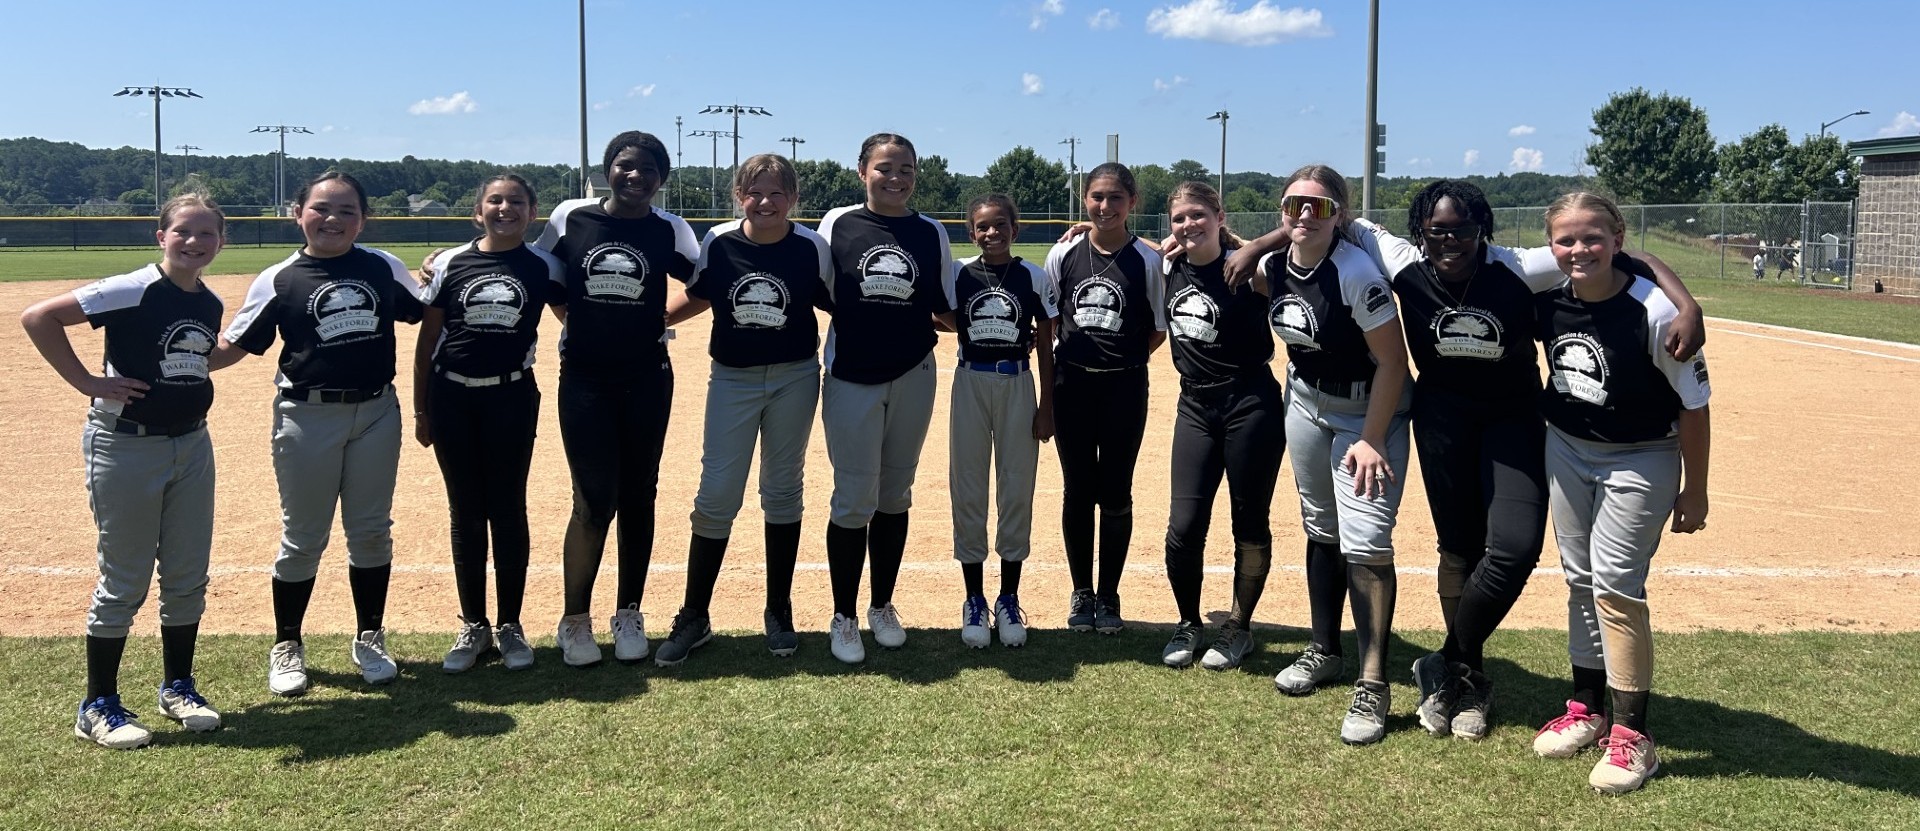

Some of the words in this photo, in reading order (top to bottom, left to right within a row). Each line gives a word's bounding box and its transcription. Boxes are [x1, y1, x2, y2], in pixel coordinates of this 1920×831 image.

[610, 283, 638, 294] FOREST
[884, 284, 908, 295] FOREST
[1462, 306, 1488, 316] Cultural
[467, 313, 487, 321] WAKE
[488, 313, 516, 323] FOREST
[755, 313, 781, 324] FOREST
[321, 322, 345, 334] WAKE
[345, 320, 374, 328] FOREST
[971, 328, 989, 336] WAKE
[990, 328, 1015, 337] FOREST
[1188, 326, 1212, 338] FOREST
[1465, 347, 1497, 356] FOREST
[1583, 333, 1602, 349] Cultural
[1597, 346, 1610, 377] Resources
[165, 362, 188, 371] WAKE
[1570, 382, 1600, 399] FOREST
